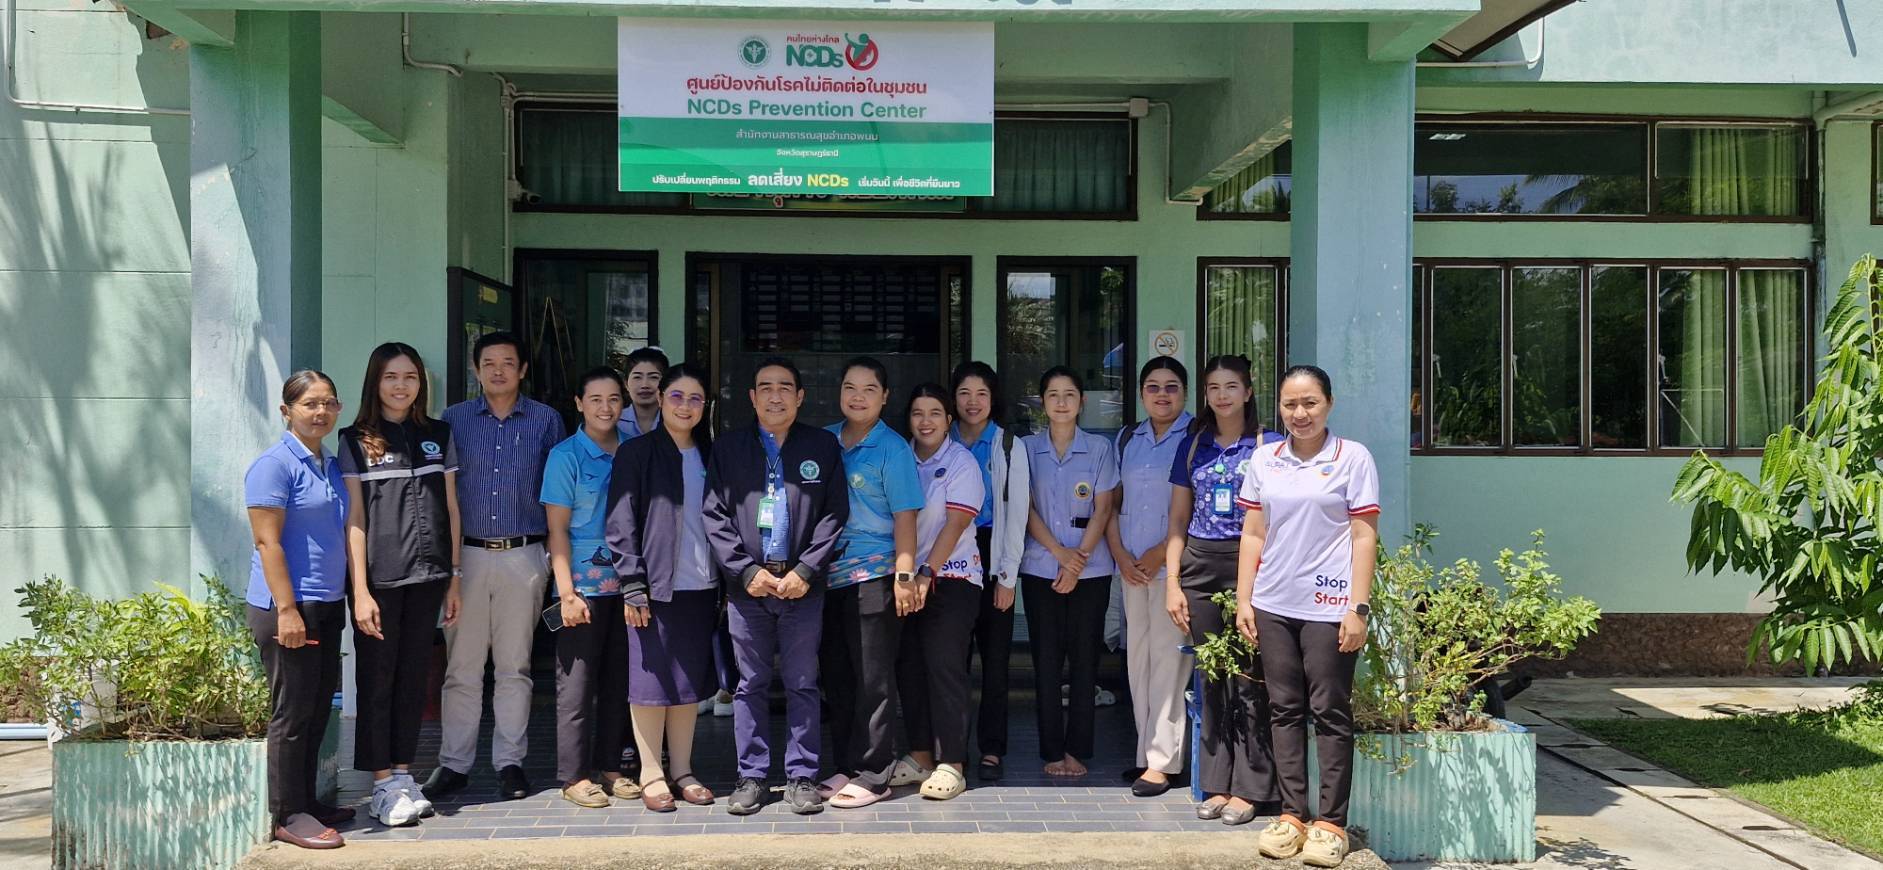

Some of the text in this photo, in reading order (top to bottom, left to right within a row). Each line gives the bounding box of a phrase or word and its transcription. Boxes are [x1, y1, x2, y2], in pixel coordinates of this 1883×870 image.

[786, 33, 840, 44] คนไทยห่างไกล
[785, 44, 844, 68] NCDs
[686, 74, 927, 99] ศูนย์ป้องกันโรคไม่ติดต่อในชุมชน
[687, 98, 927, 119] NCDs Prevention Center
[652, 174, 741, 187] ปรับเปลี่ยนพฤติกรรม
[747, 168, 803, 187] ลดเสี่ยง
[807, 174, 849, 187] NCDs
[858, 175, 891, 188] เริ่มวันนี้
[1315, 574, 1348, 592] Stop
[1314, 592, 1349, 606] Start
